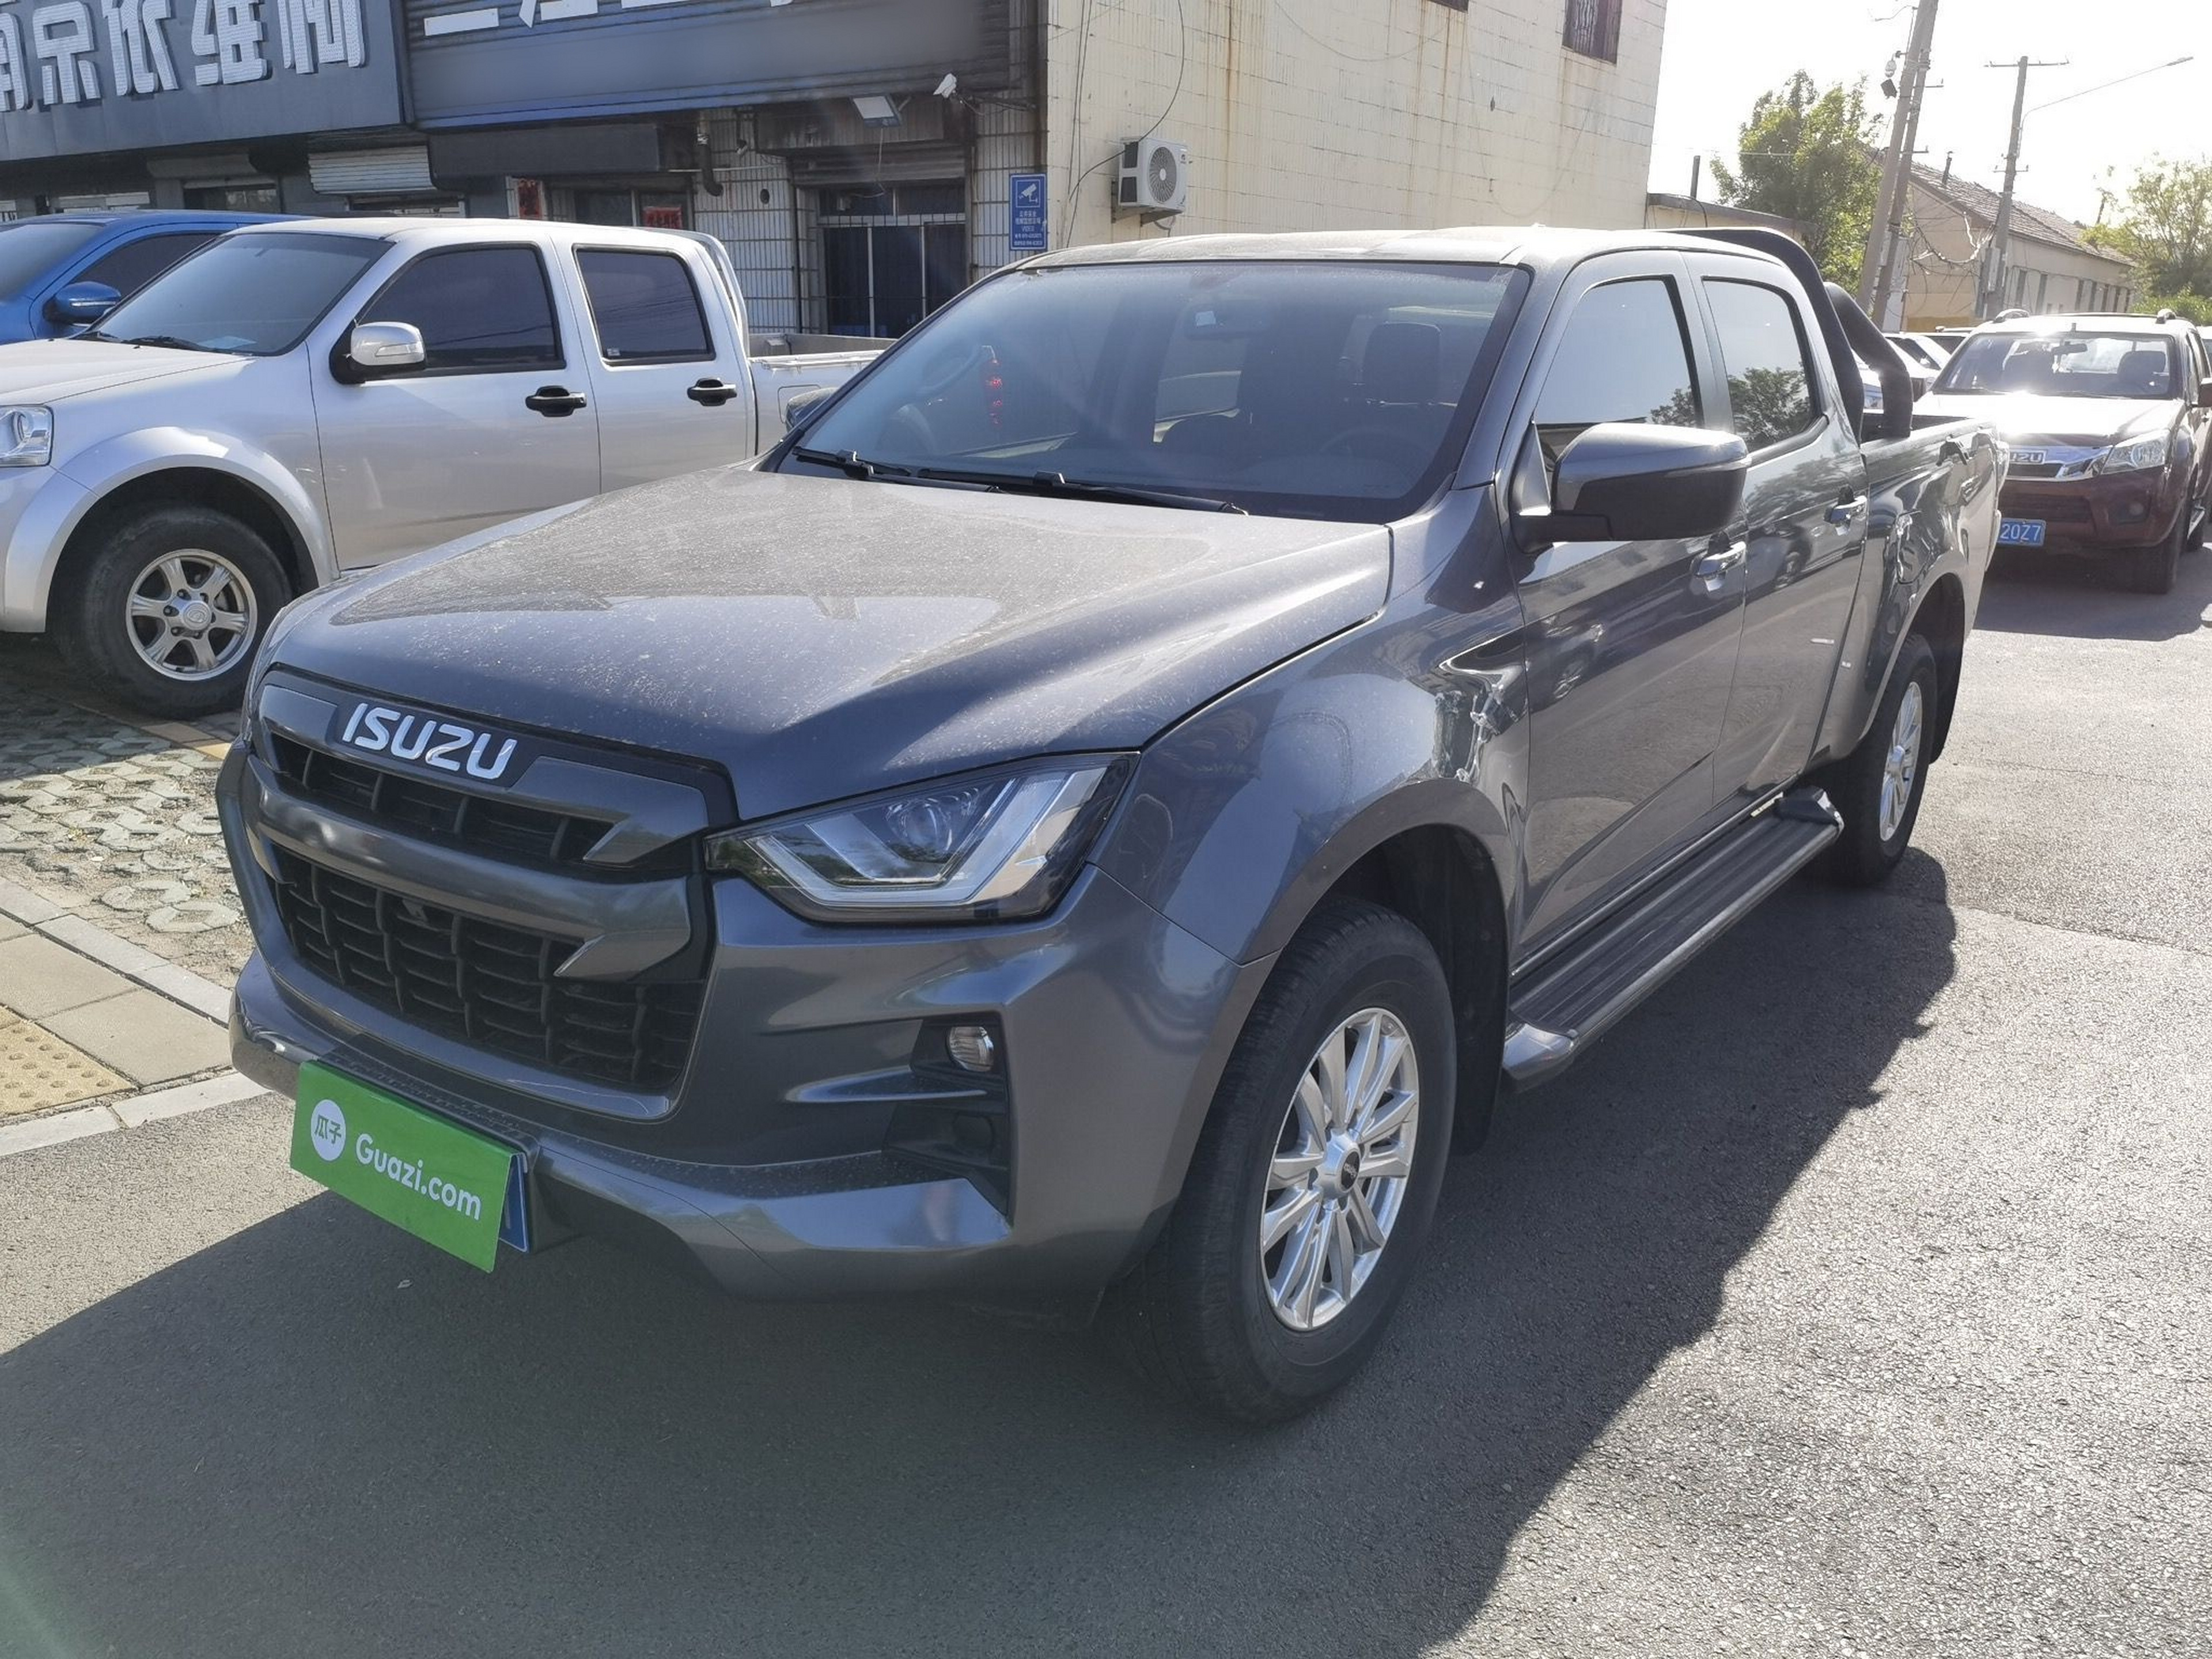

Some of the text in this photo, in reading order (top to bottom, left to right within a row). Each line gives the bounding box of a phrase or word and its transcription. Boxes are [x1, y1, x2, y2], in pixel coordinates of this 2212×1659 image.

[2000, 523, 2042, 541] 20Z7
[342, 702, 518, 779] ISUZU
[314, 1114, 342, 1145] 瓜子
[355, 1133, 482, 1221] Guazi.com
